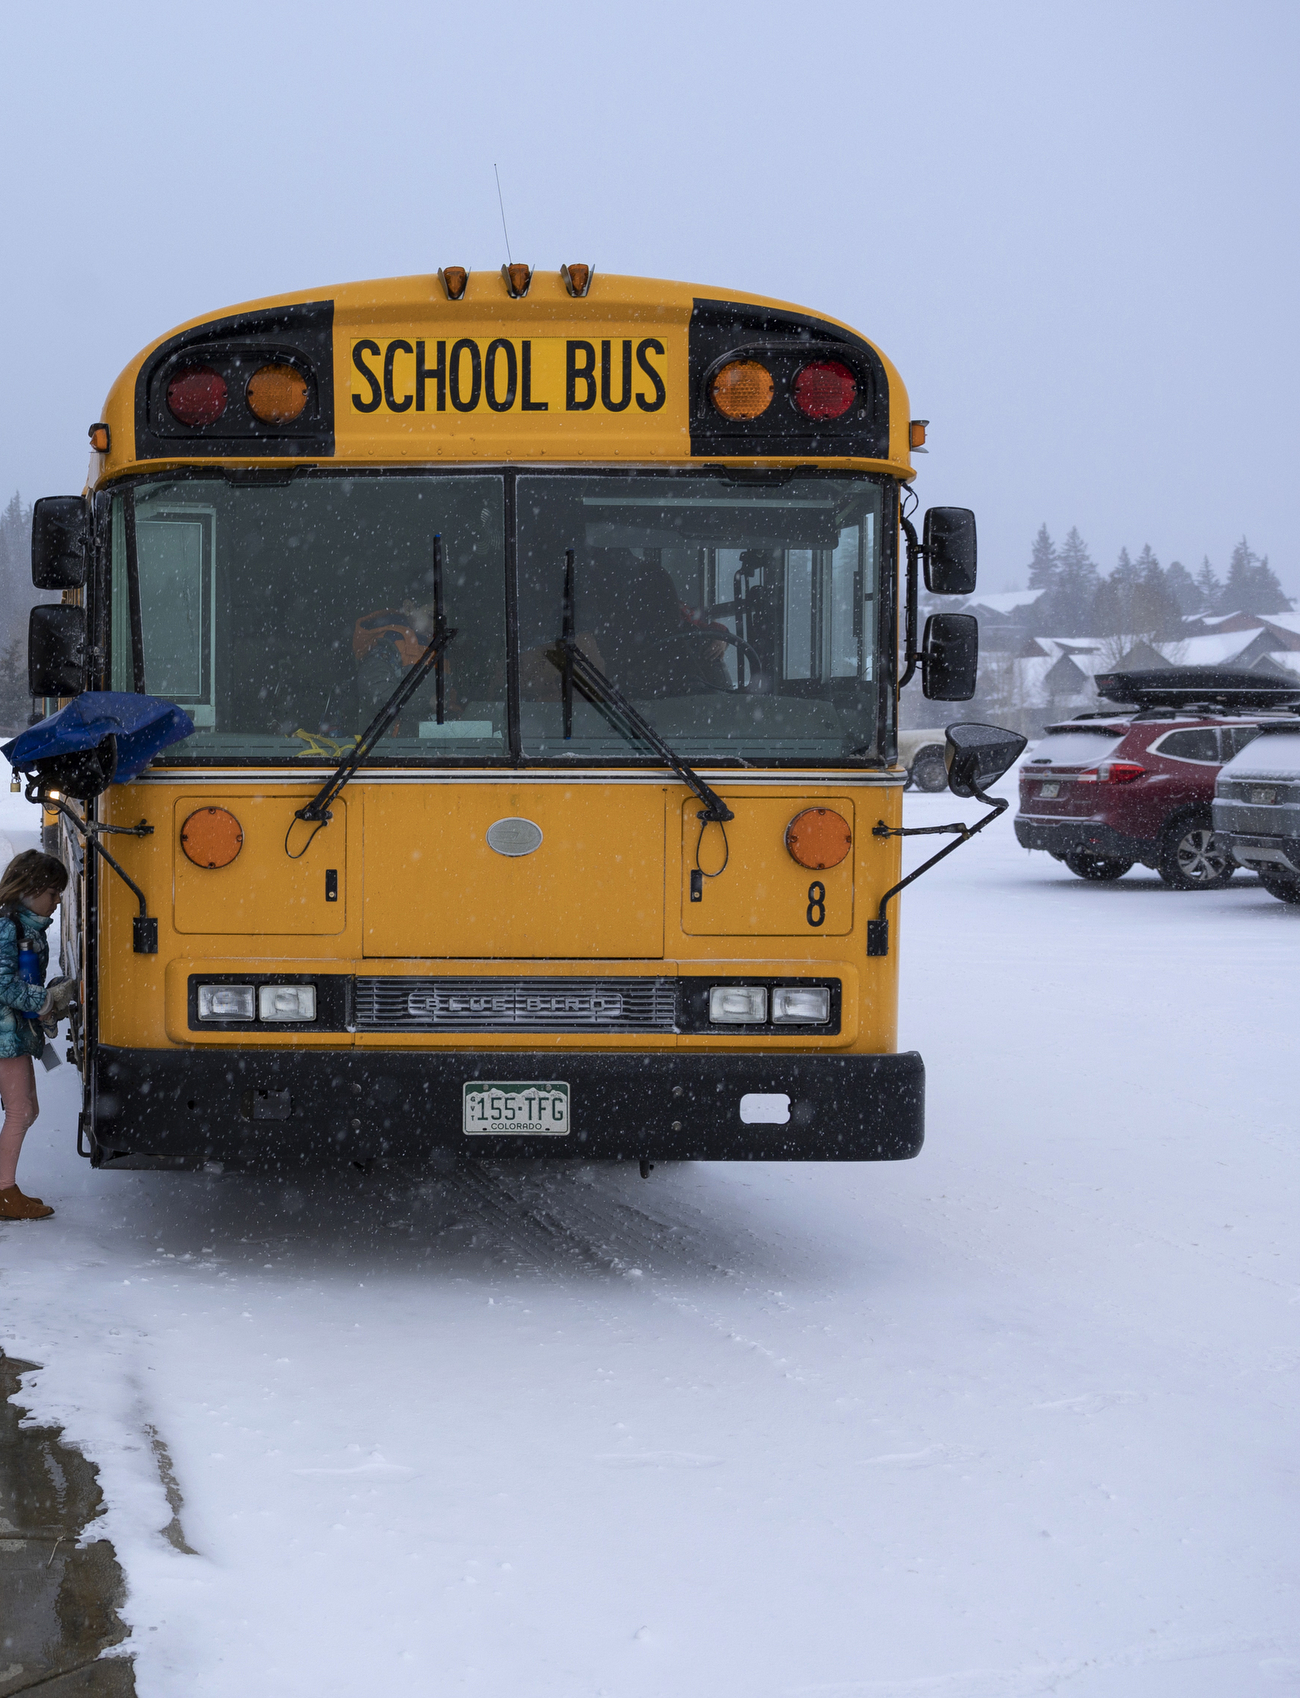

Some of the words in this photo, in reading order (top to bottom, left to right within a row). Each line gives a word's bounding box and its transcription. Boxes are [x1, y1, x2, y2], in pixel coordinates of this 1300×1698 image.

[351, 338, 549, 413] SCHOOL
[565, 338, 666, 413] BUS
[806, 881, 826, 928] 8
[425, 998, 506, 1011] BLUE
[526, 998, 605, 1011] BIRD
